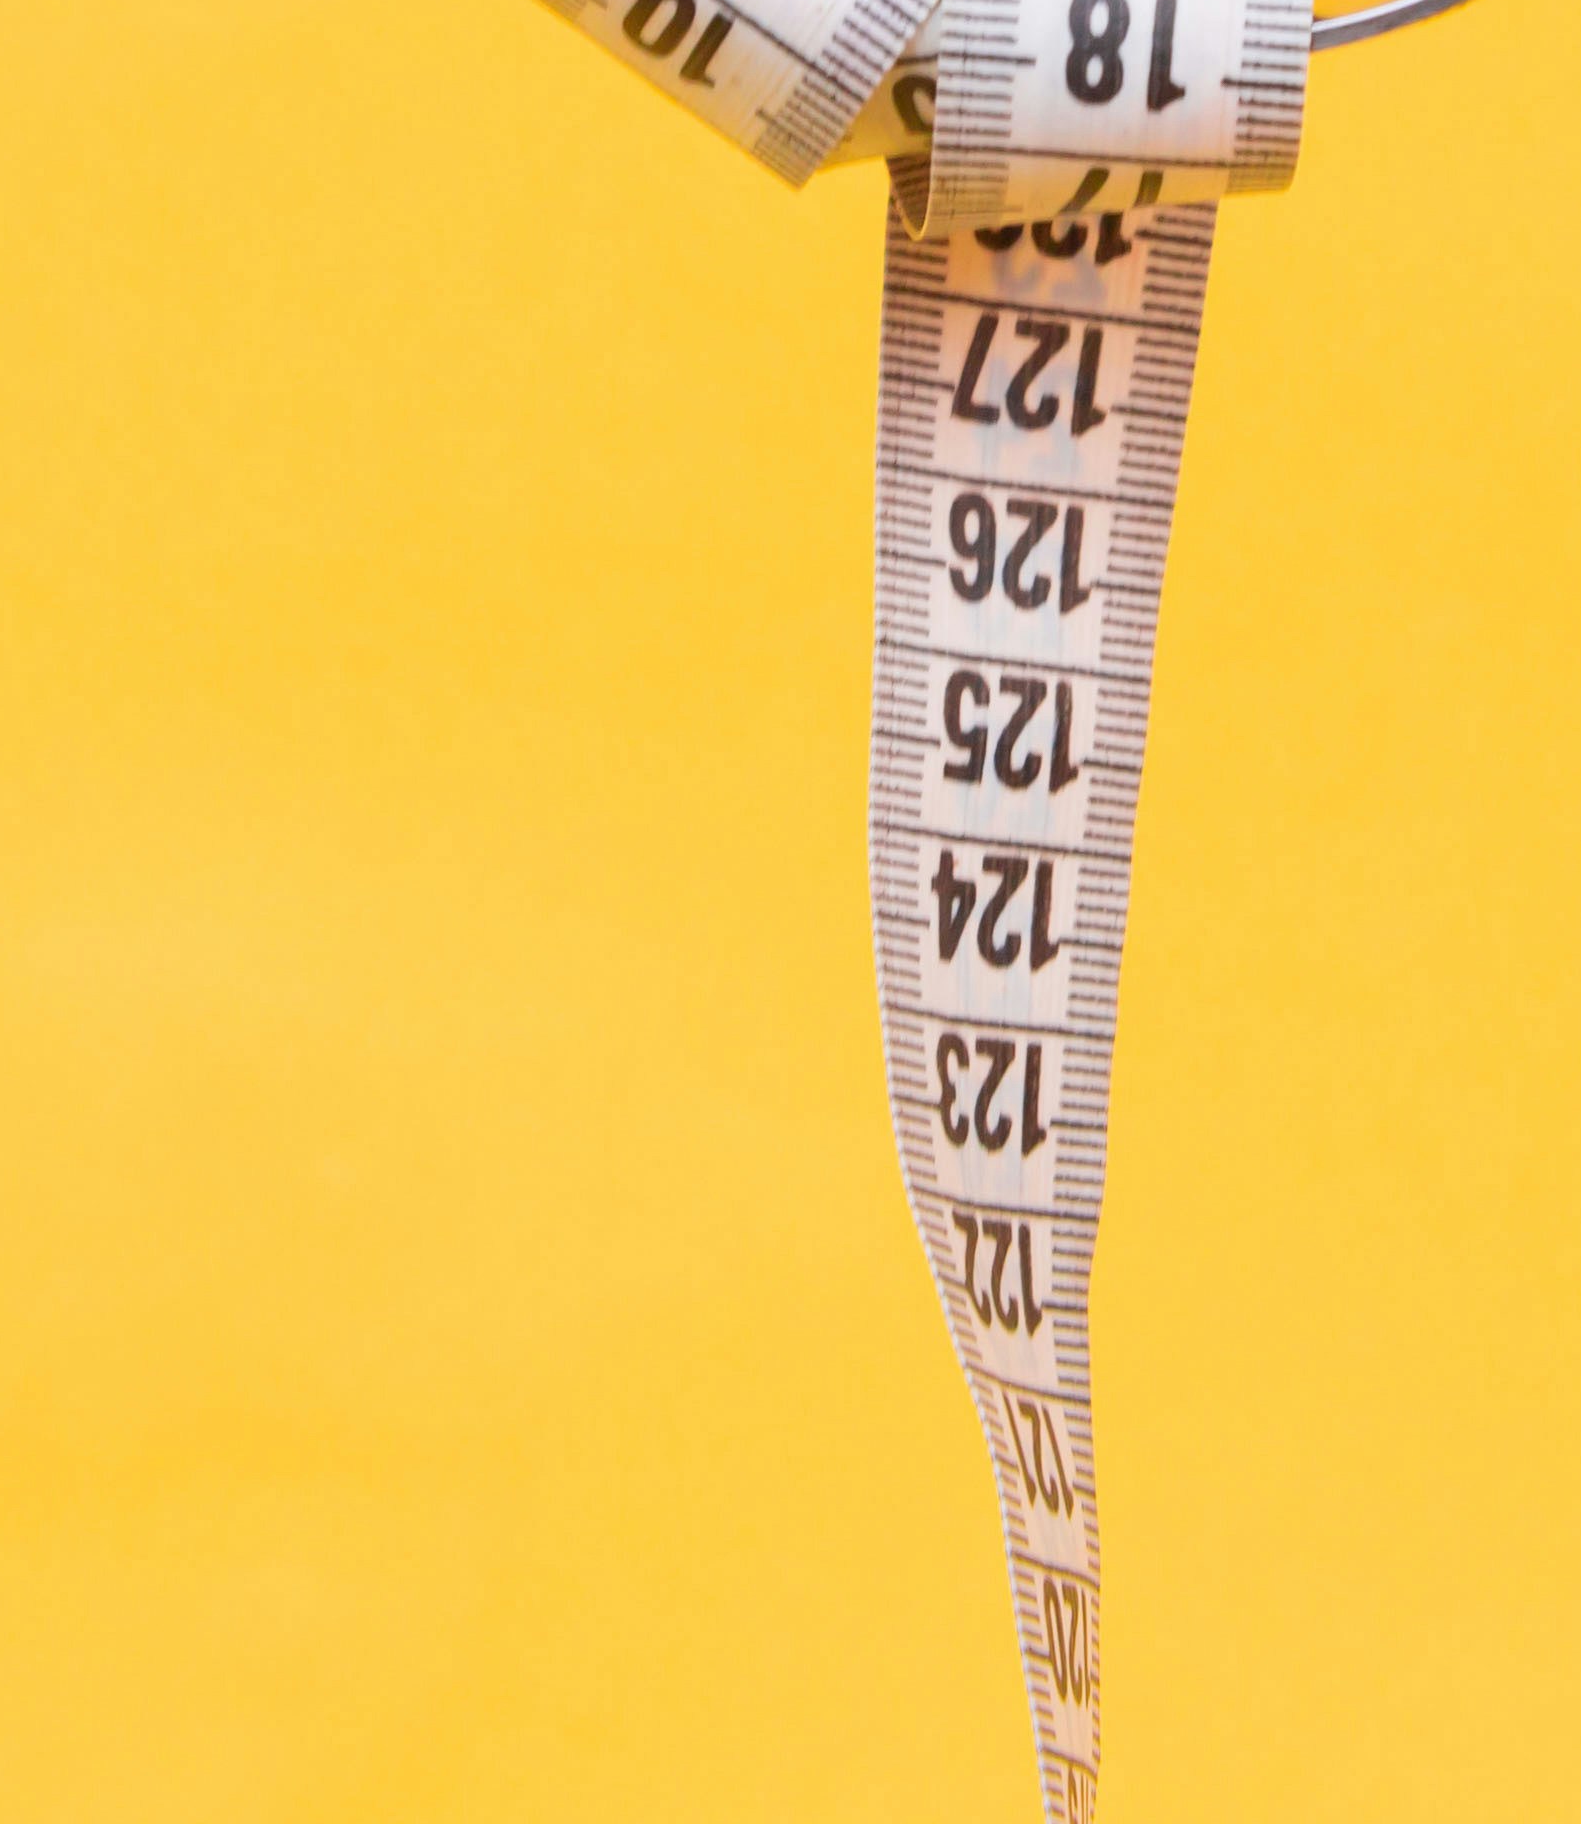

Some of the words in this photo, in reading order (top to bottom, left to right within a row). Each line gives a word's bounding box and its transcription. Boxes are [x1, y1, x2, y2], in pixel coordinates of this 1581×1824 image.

[950, 311, 1107, 438] 127
[947, 491, 1091, 615] 126
[942, 669, 1080, 794] 125
[930, 848, 1060, 972] 124
[935, 1032, 1048, 1158] 123
[951, 1208, 1044, 1338] 122
[1001, 1391, 1075, 1520] 121
[1041, 1576, 1092, 1708] 120
